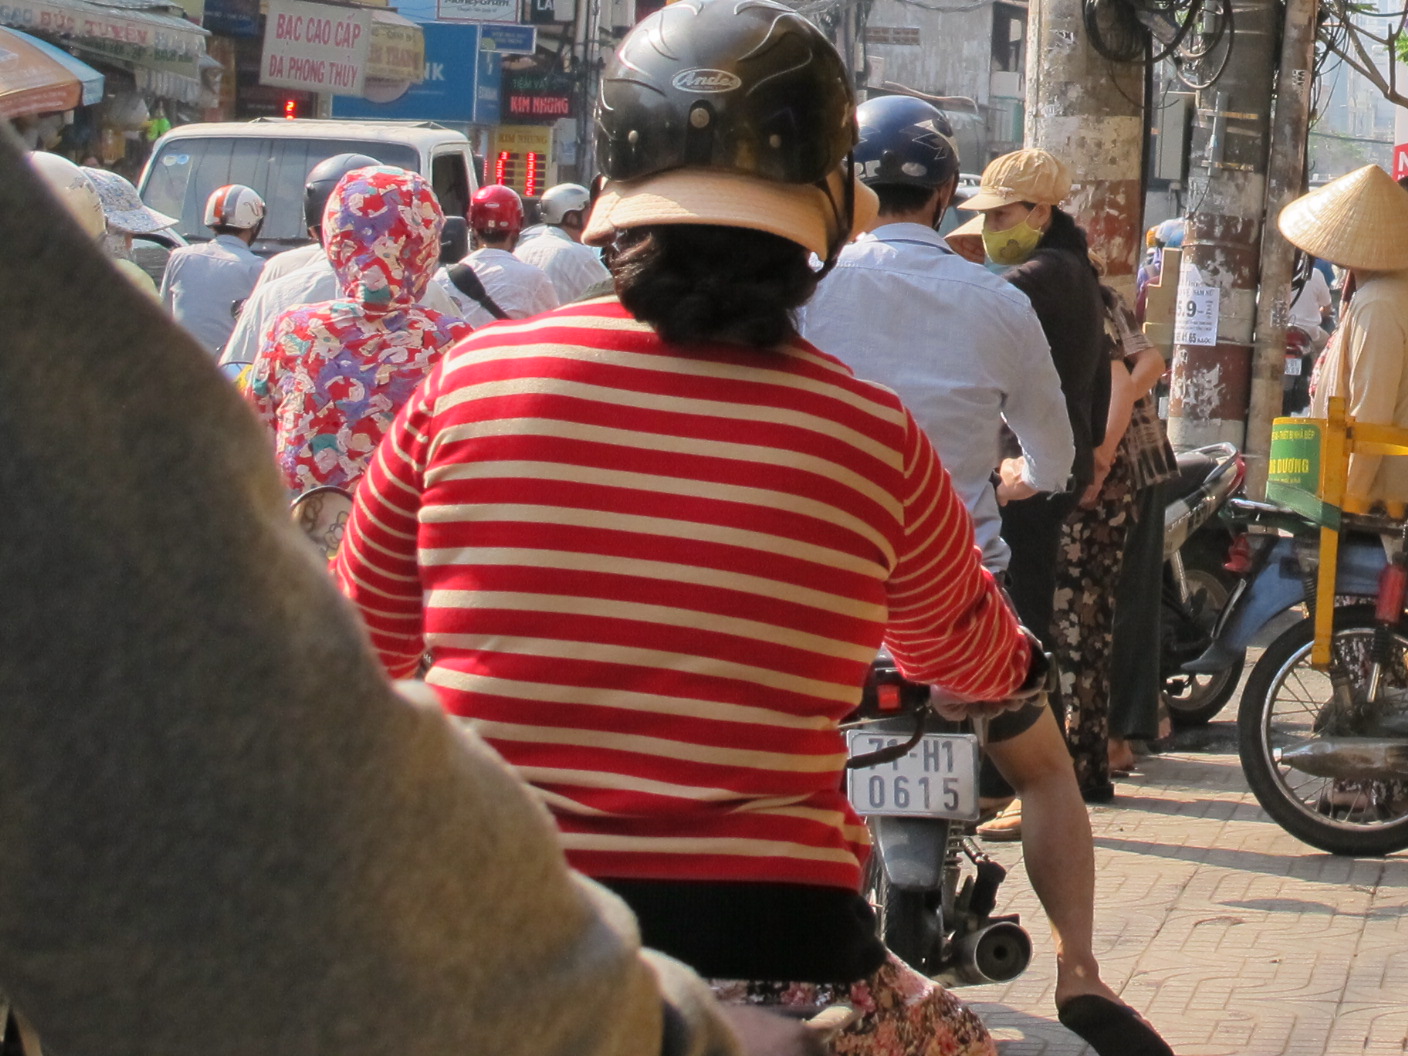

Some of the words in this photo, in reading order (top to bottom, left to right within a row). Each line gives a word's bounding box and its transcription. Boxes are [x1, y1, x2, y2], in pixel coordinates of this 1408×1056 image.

[306, 16, 331, 45] CAO
[335, 13, 362, 49] CẤP
[288, 57, 326, 84] PHONG
[868, 774, 960, 812] 0615
